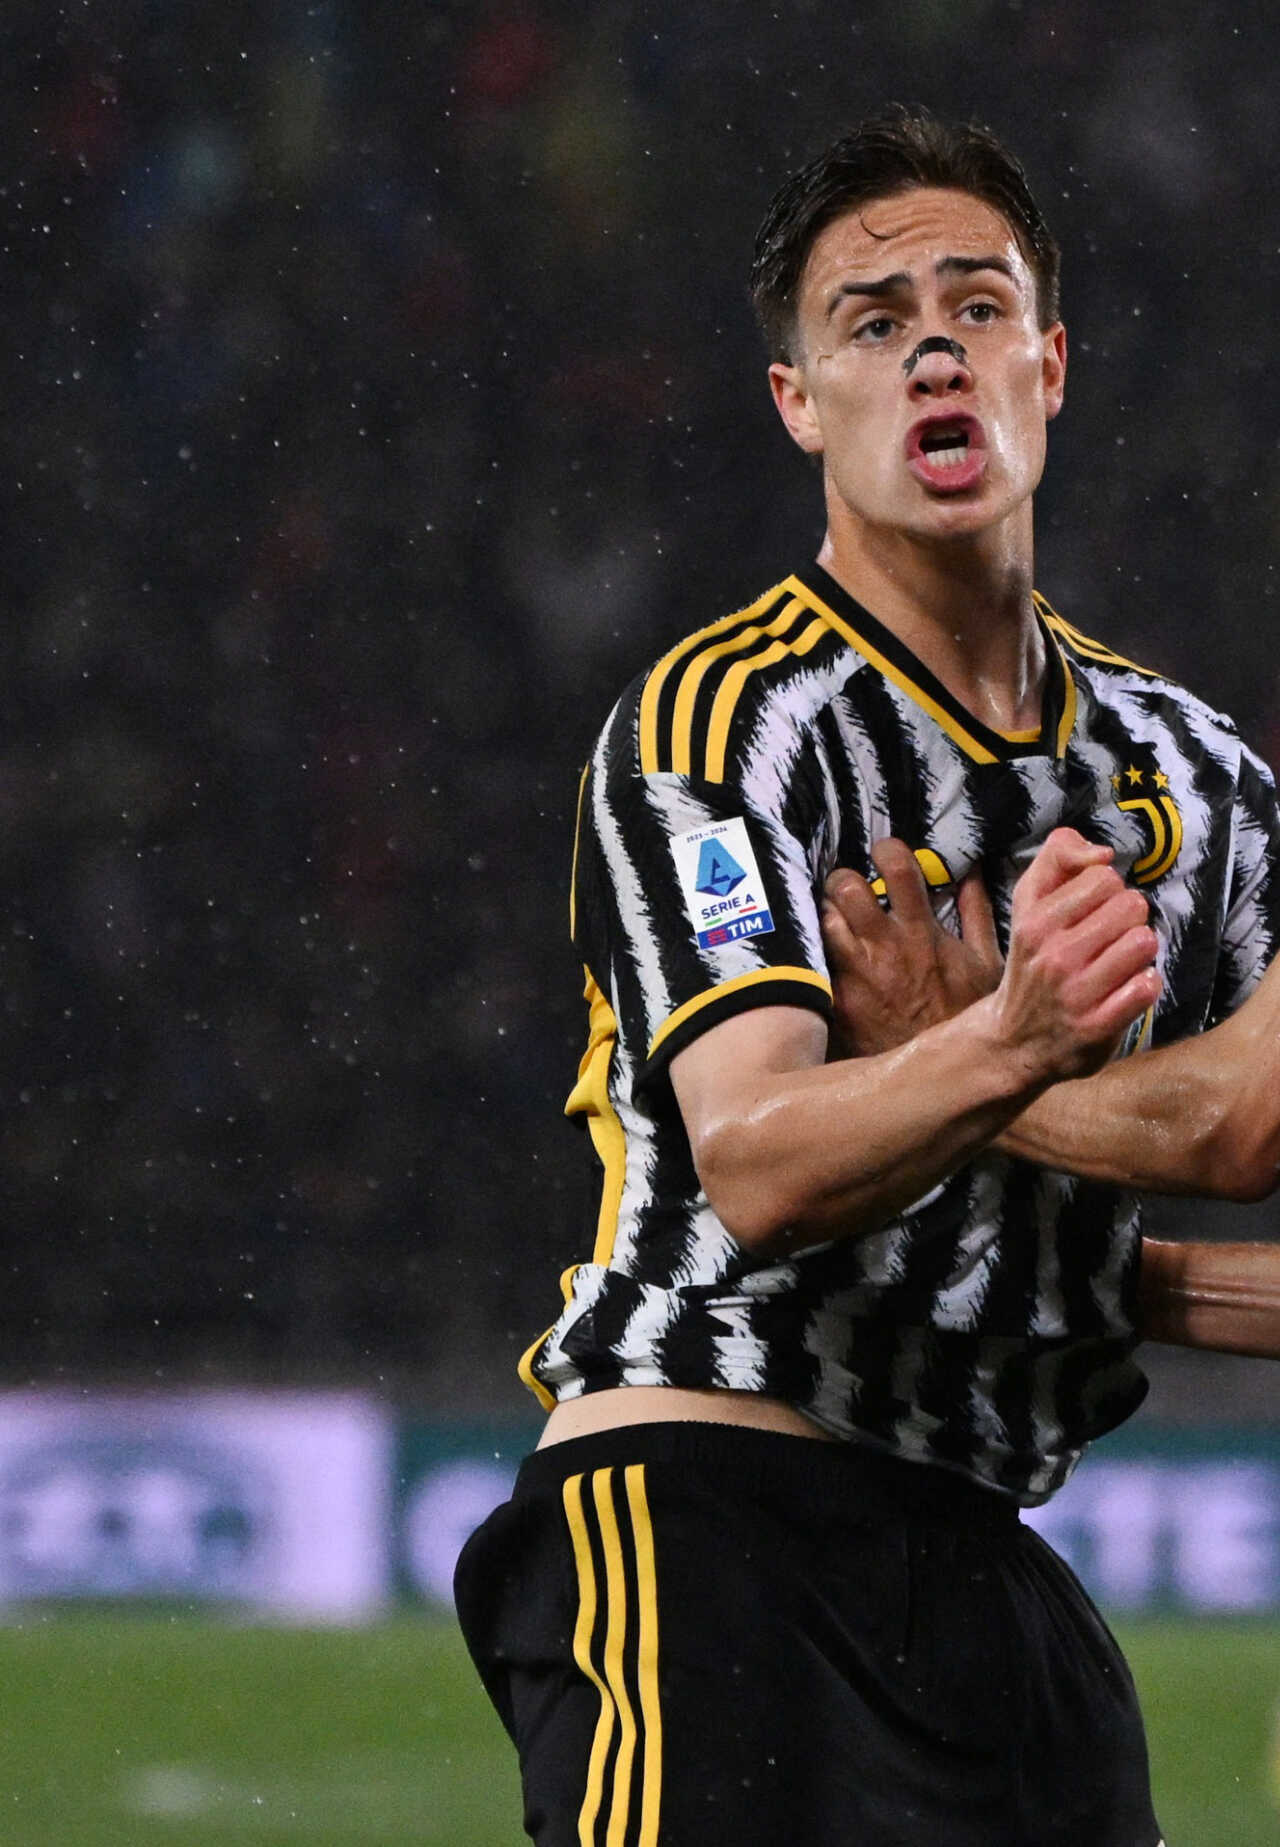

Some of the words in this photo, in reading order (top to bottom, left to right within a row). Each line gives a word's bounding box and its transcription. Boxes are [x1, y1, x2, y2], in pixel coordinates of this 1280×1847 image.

[701, 896, 742, 920] SERIE
[745, 893, 756, 905] A
[727, 916, 764, 938] TIM
